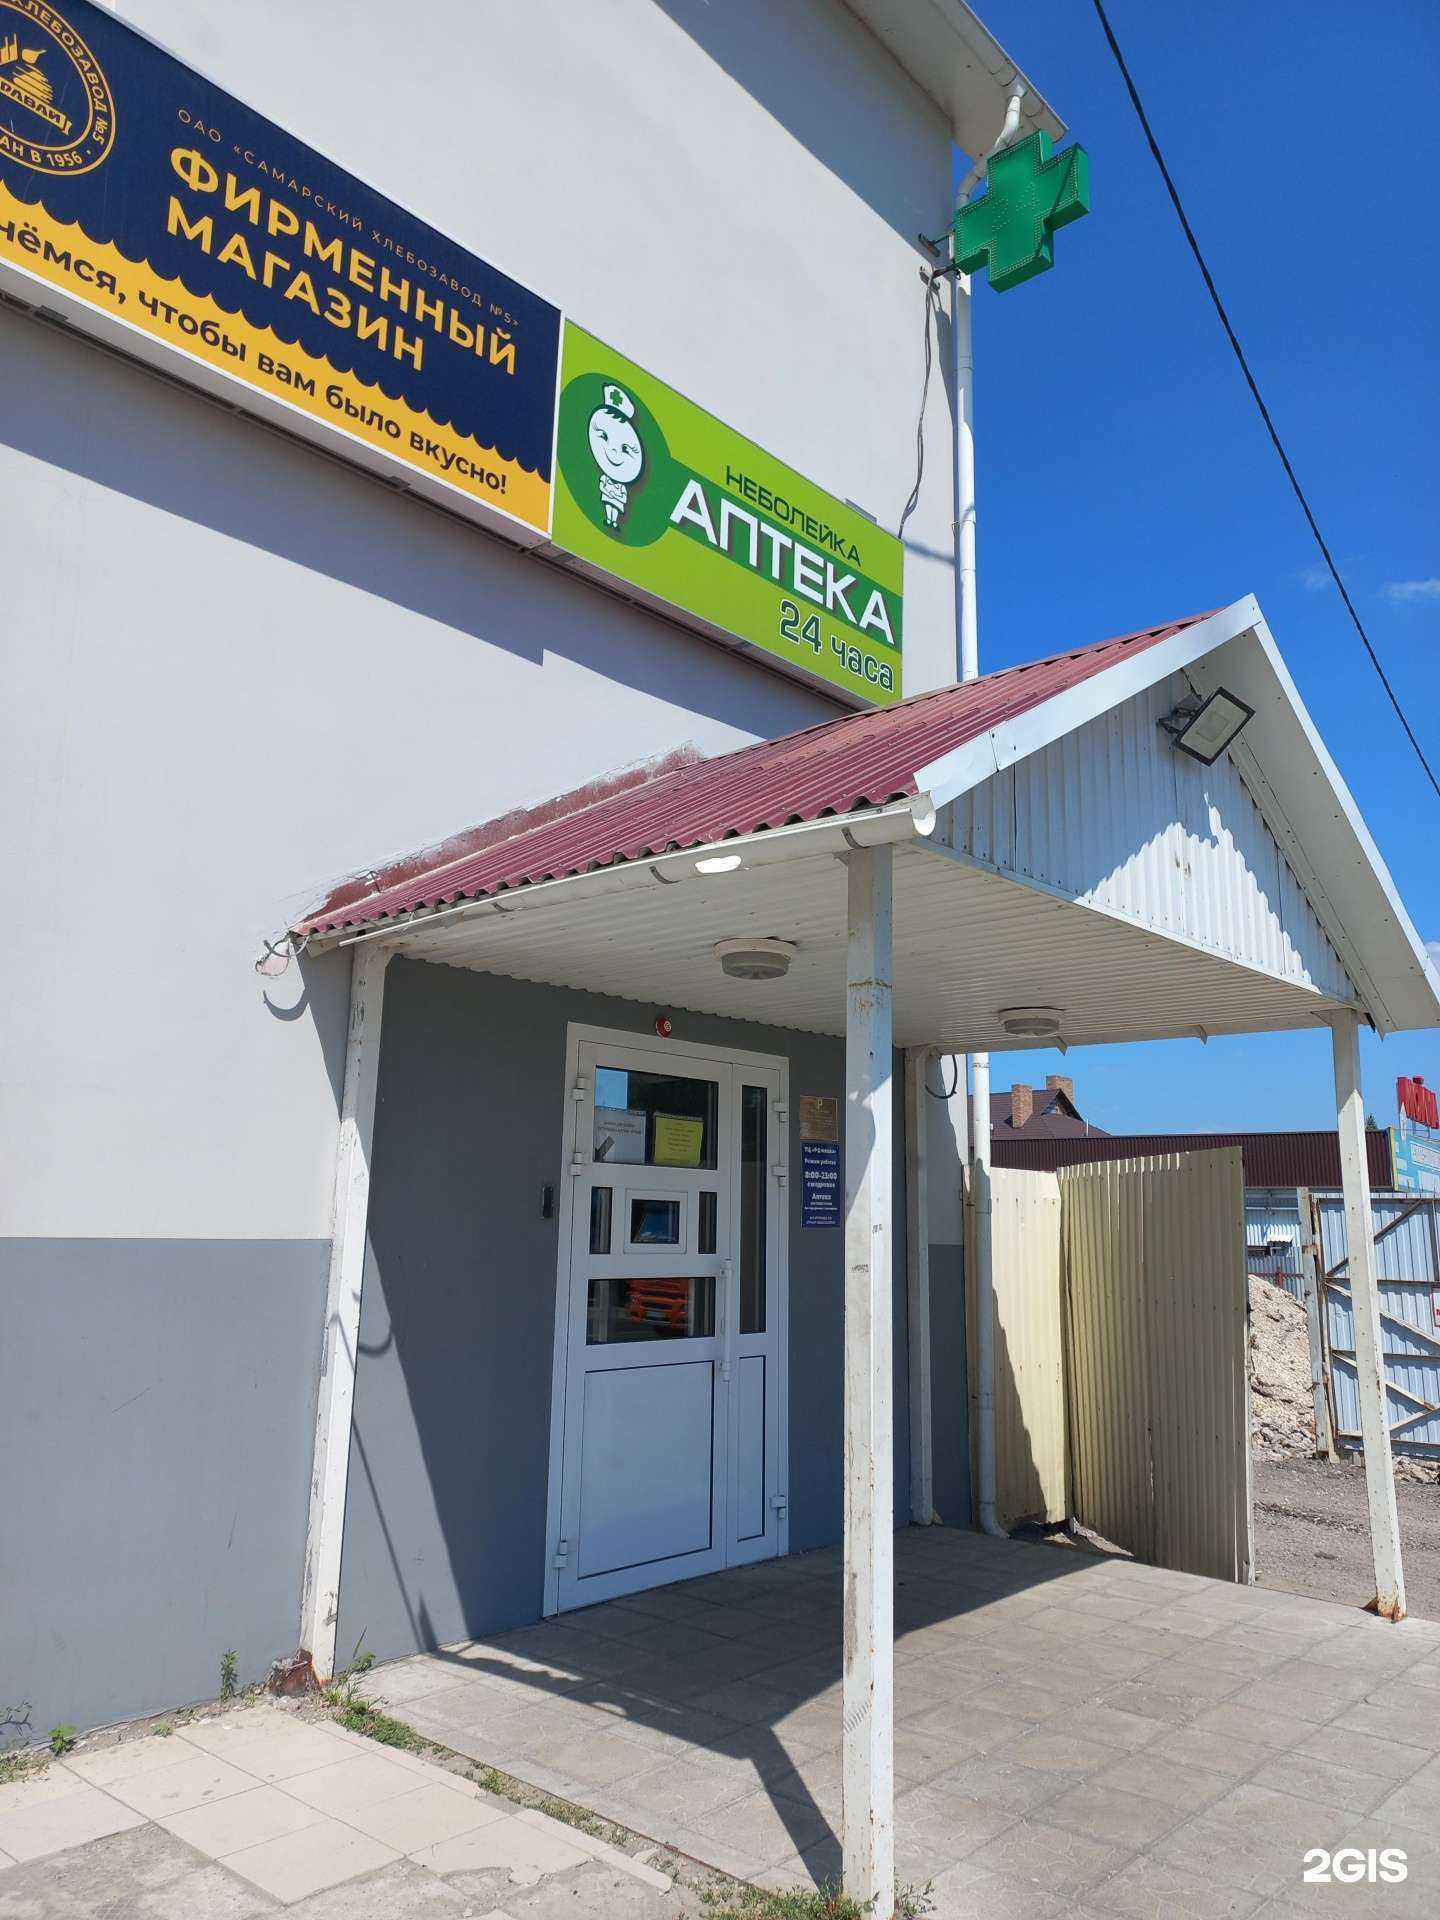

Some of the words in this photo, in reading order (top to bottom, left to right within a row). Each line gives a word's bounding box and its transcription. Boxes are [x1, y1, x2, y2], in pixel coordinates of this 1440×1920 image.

[30, 149, 42, 163] В
[46, 150, 83, 167] 1956
[92, 116, 108, 145] №5
[178, 109, 221, 142] ОАО
[233, 144, 363, 232] «САМАРСКИЙ
[372, 229, 482, 307] ХЛЕБОЗАВОД
[167, 195, 424, 371] МАГАЗИН
[170, 147, 516, 375] ФИРМЕННЫЙ
[139, 290, 247, 362] чтобы
[258, 353, 316, 397] вам
[326, 384, 401, 439] было
[410, 431, 507, 495] вкусно!
[669, 479, 896, 646] АПТЕКА
[726, 465, 862, 567] НЕБОЛЕЙКА
[779, 599, 823, 655] 24
[830, 633, 894, 693] часа
